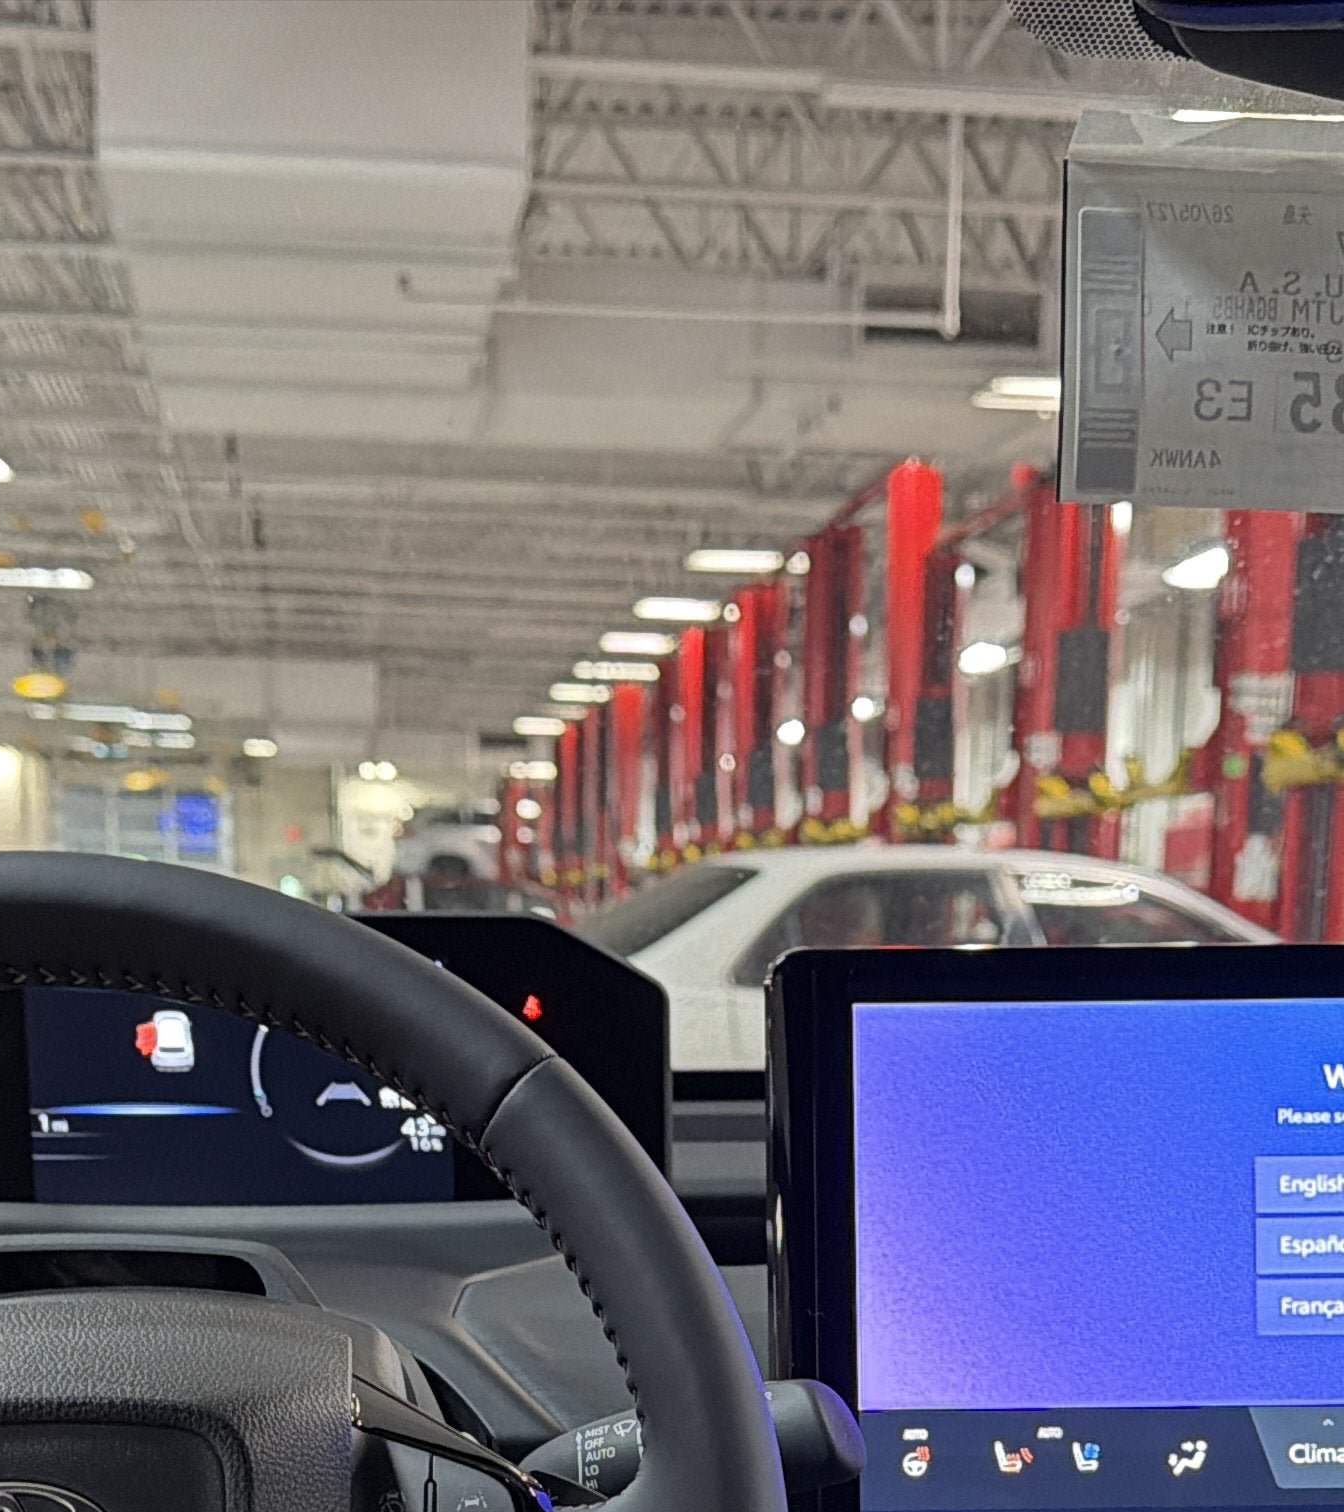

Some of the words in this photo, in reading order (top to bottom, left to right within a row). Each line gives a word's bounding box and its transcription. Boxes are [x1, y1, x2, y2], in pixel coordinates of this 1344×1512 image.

[1277, 1107, 1331, 1125] Please
[585, 1424, 610, 1439] MIST
[585, 1437, 605, 1450] OFF
[586, 1447, 616, 1462] AUTO
[585, 1465, 599, 1476] LO
[586, 1479, 598, 1489] HI
